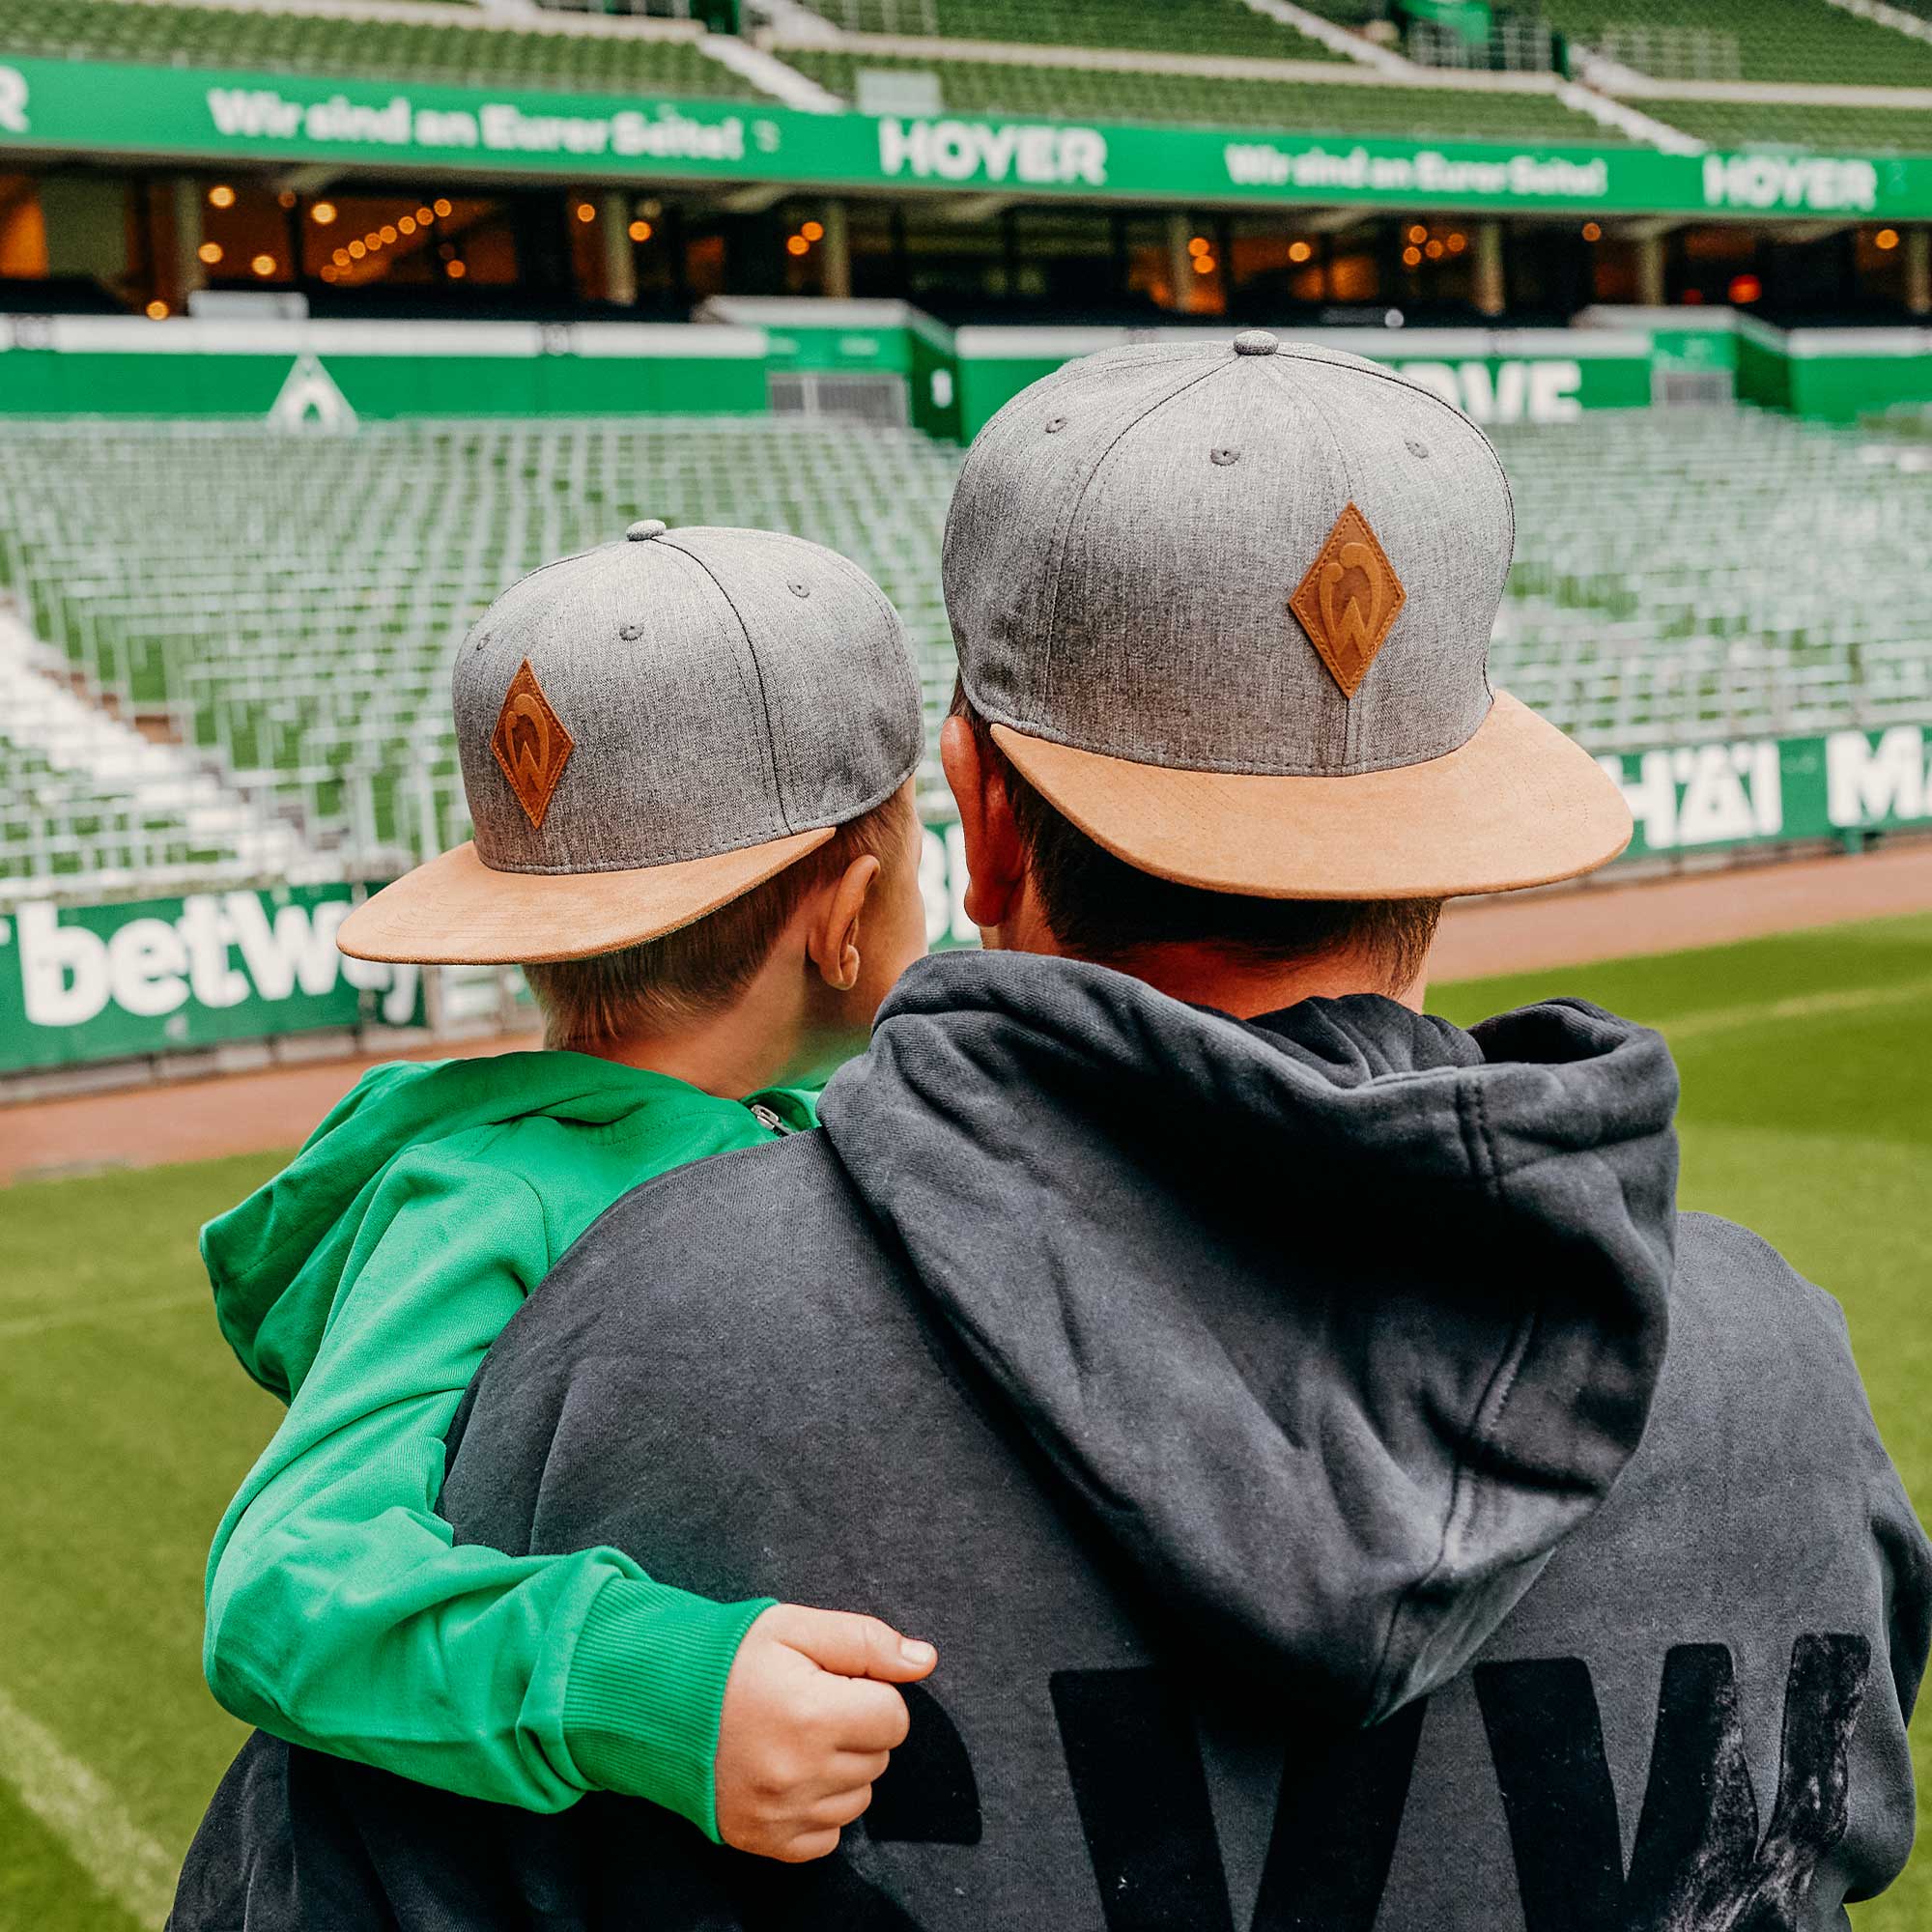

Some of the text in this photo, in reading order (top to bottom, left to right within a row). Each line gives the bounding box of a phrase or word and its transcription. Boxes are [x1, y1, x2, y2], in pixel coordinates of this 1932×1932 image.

[207, 88, 303, 137] Wir
[305, 95, 412, 144] sind
[414, 110, 478, 147] an
[878, 117, 1108, 185] HOYER
[1224, 145, 1290, 185] Wir
[1292, 147, 1368, 187] sind
[1369, 156, 1412, 190] an
[1702, 153, 1877, 212] HOYER
[1826, 725, 1932, 828] M
